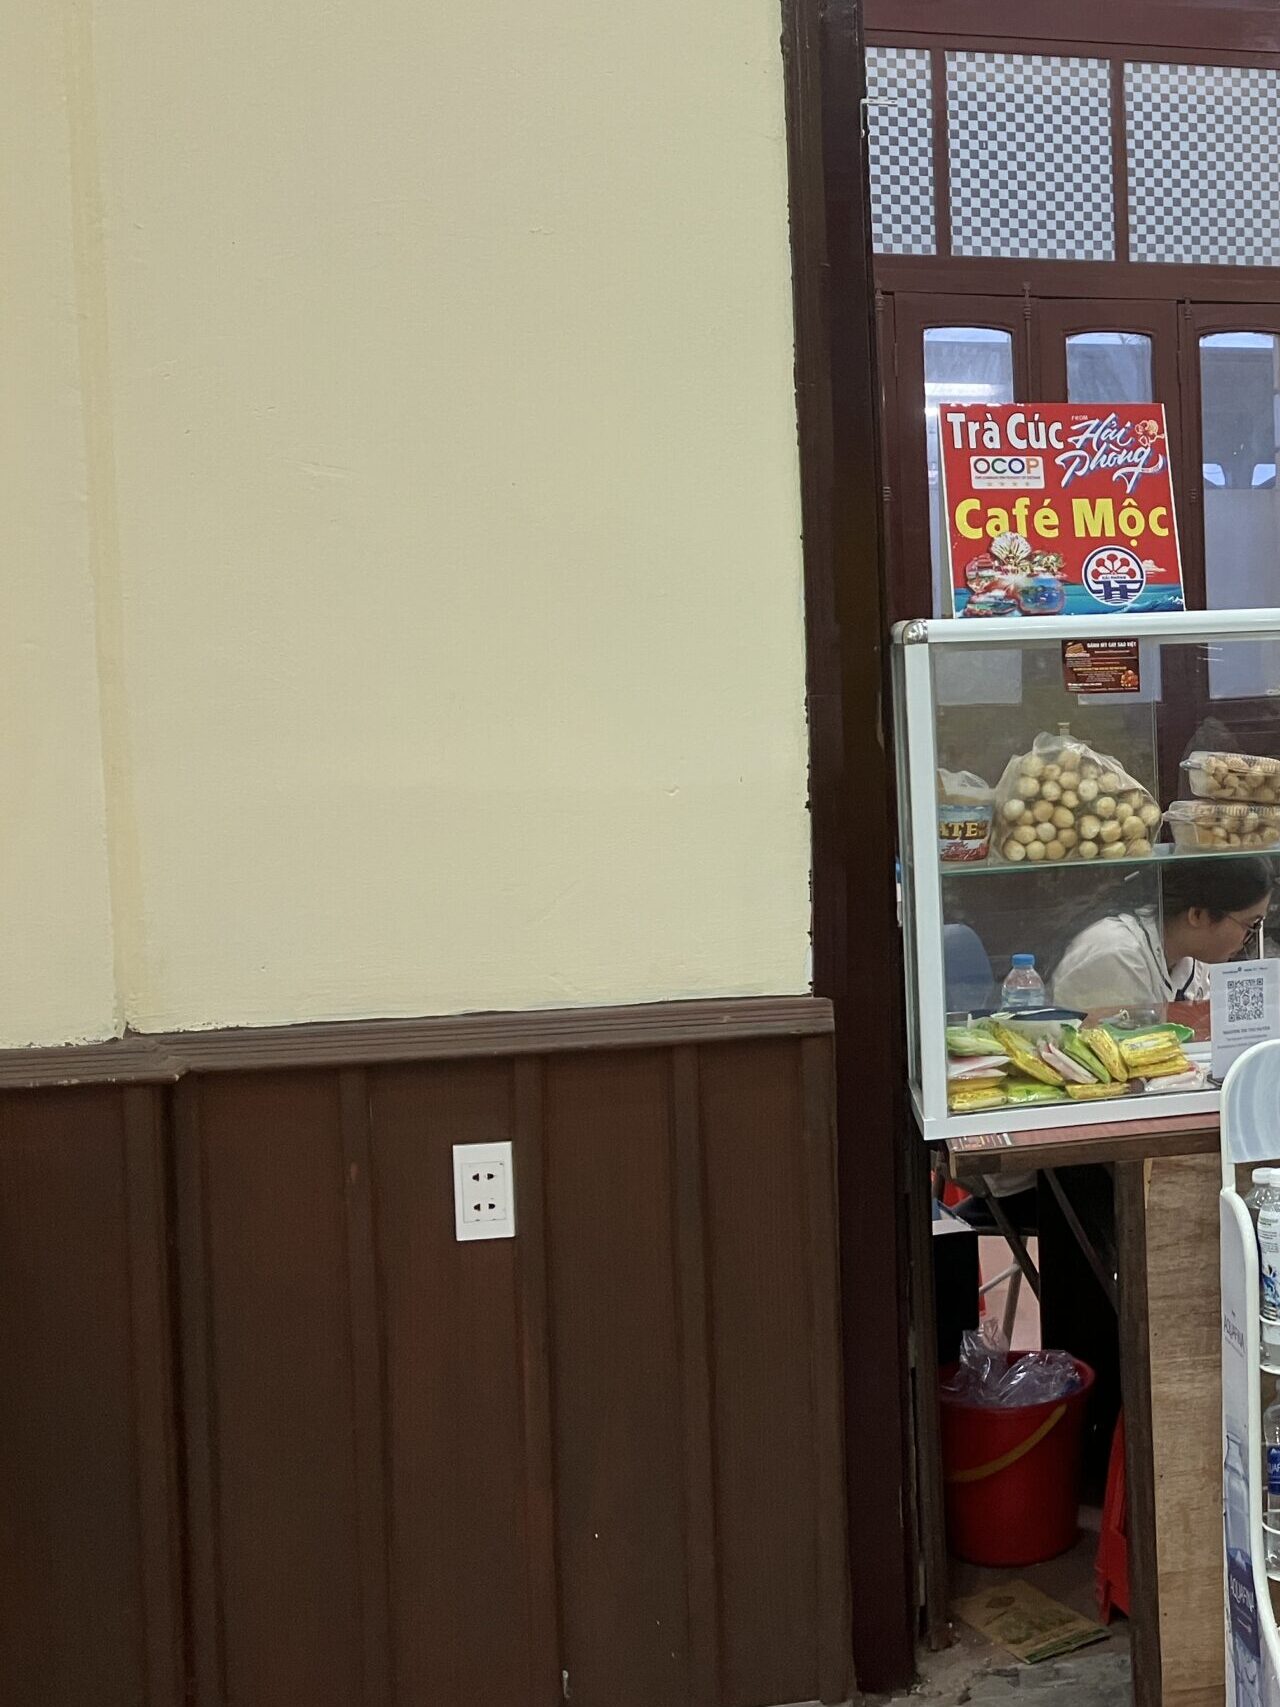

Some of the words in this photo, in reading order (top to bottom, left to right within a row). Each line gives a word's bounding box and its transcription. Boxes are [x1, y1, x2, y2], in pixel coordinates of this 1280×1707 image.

[947, 412, 1000, 449] Trà
[1006, 412, 1065, 449] Cúc
[1067, 412, 1135, 449] Hải
[973, 458, 1039, 475] OCOP
[1054, 444, 1164, 494] Phòng
[955, 497, 1059, 539] Café
[1071, 497, 1169, 547] Mộc
